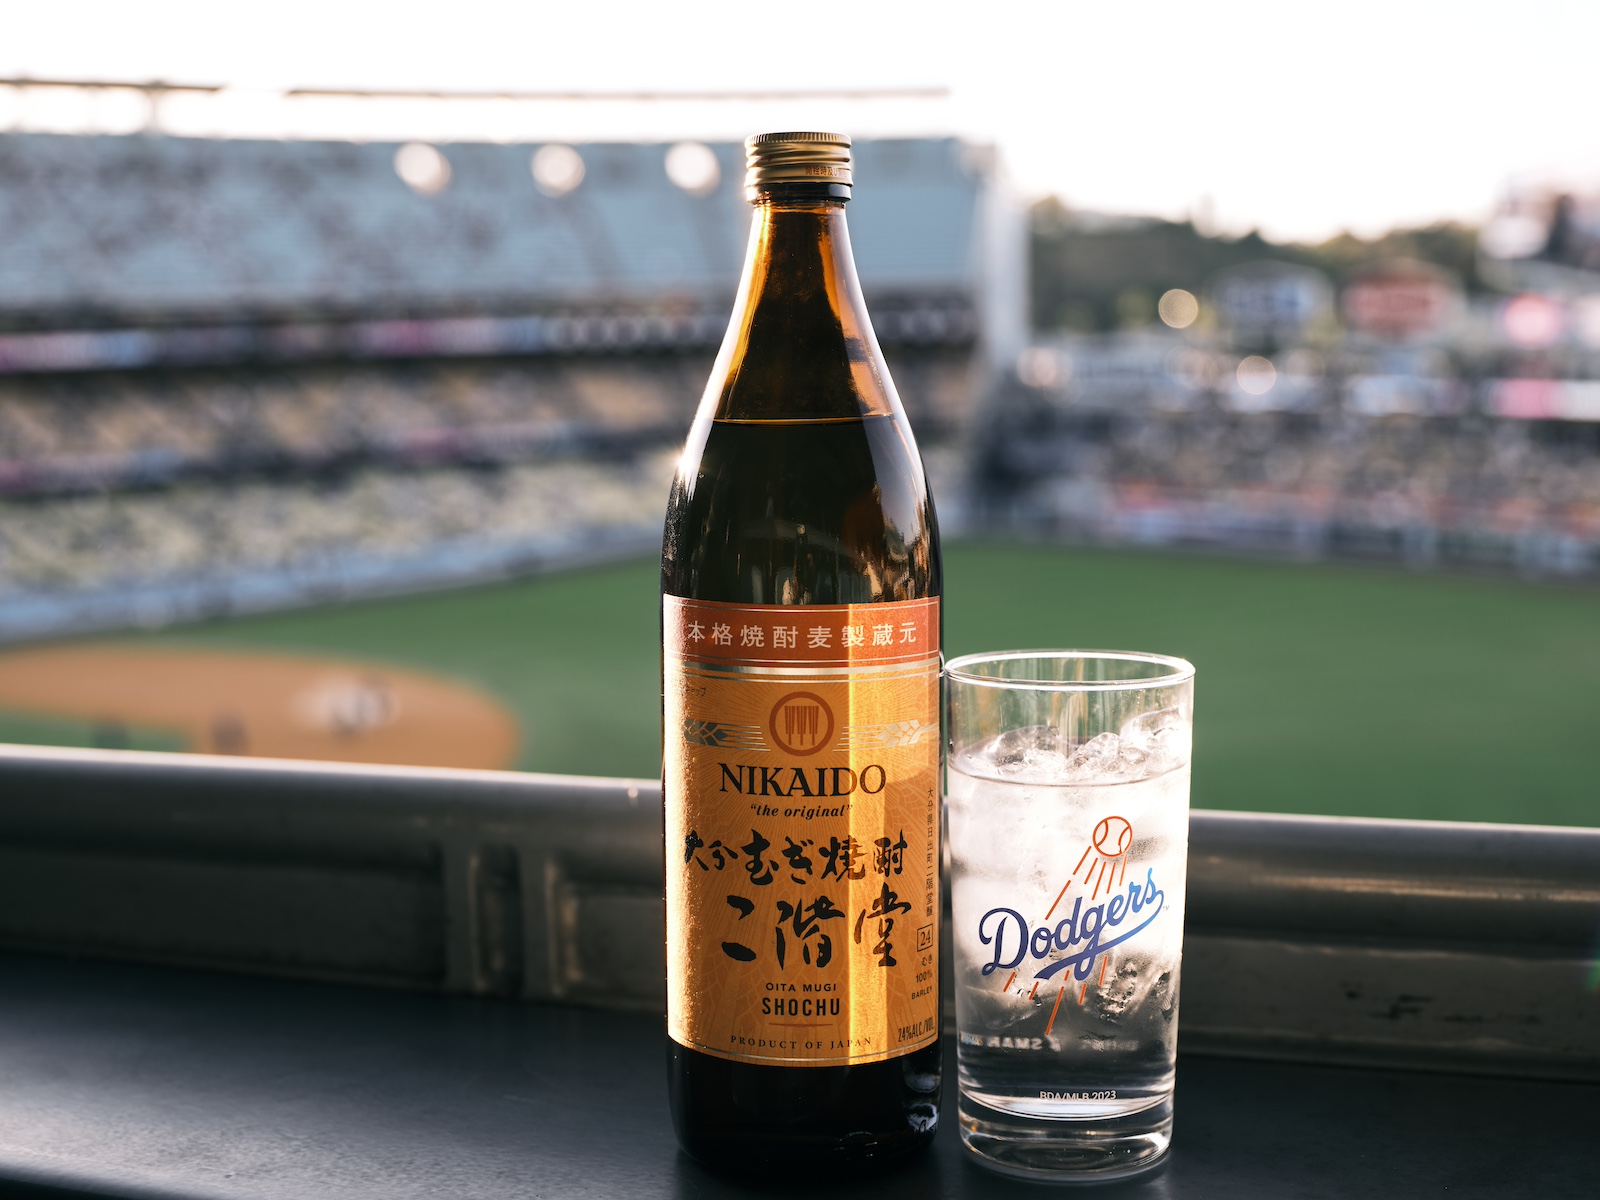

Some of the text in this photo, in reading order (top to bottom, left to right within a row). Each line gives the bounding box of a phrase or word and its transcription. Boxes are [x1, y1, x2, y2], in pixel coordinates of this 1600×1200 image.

[687, 620, 917, 649] 本格焼酎麦製蔵元
[718, 762, 887, 797] NIKAIDO
[721, 882, 912, 971] 二階堂
[978, 867, 1165, 981] Dodgers
[919, 929, 931, 947] 24
[915, 969, 933, 983] 100%
[765, 983, 837, 992] OITA MUGI
[911, 986, 933, 1000] BARLEY
[761, 997, 841, 1016] SHOCHU
[730, 1035, 872, 1050] PRODUCT OF JAPAN
[1091, 1090, 1117, 1100] 2023
